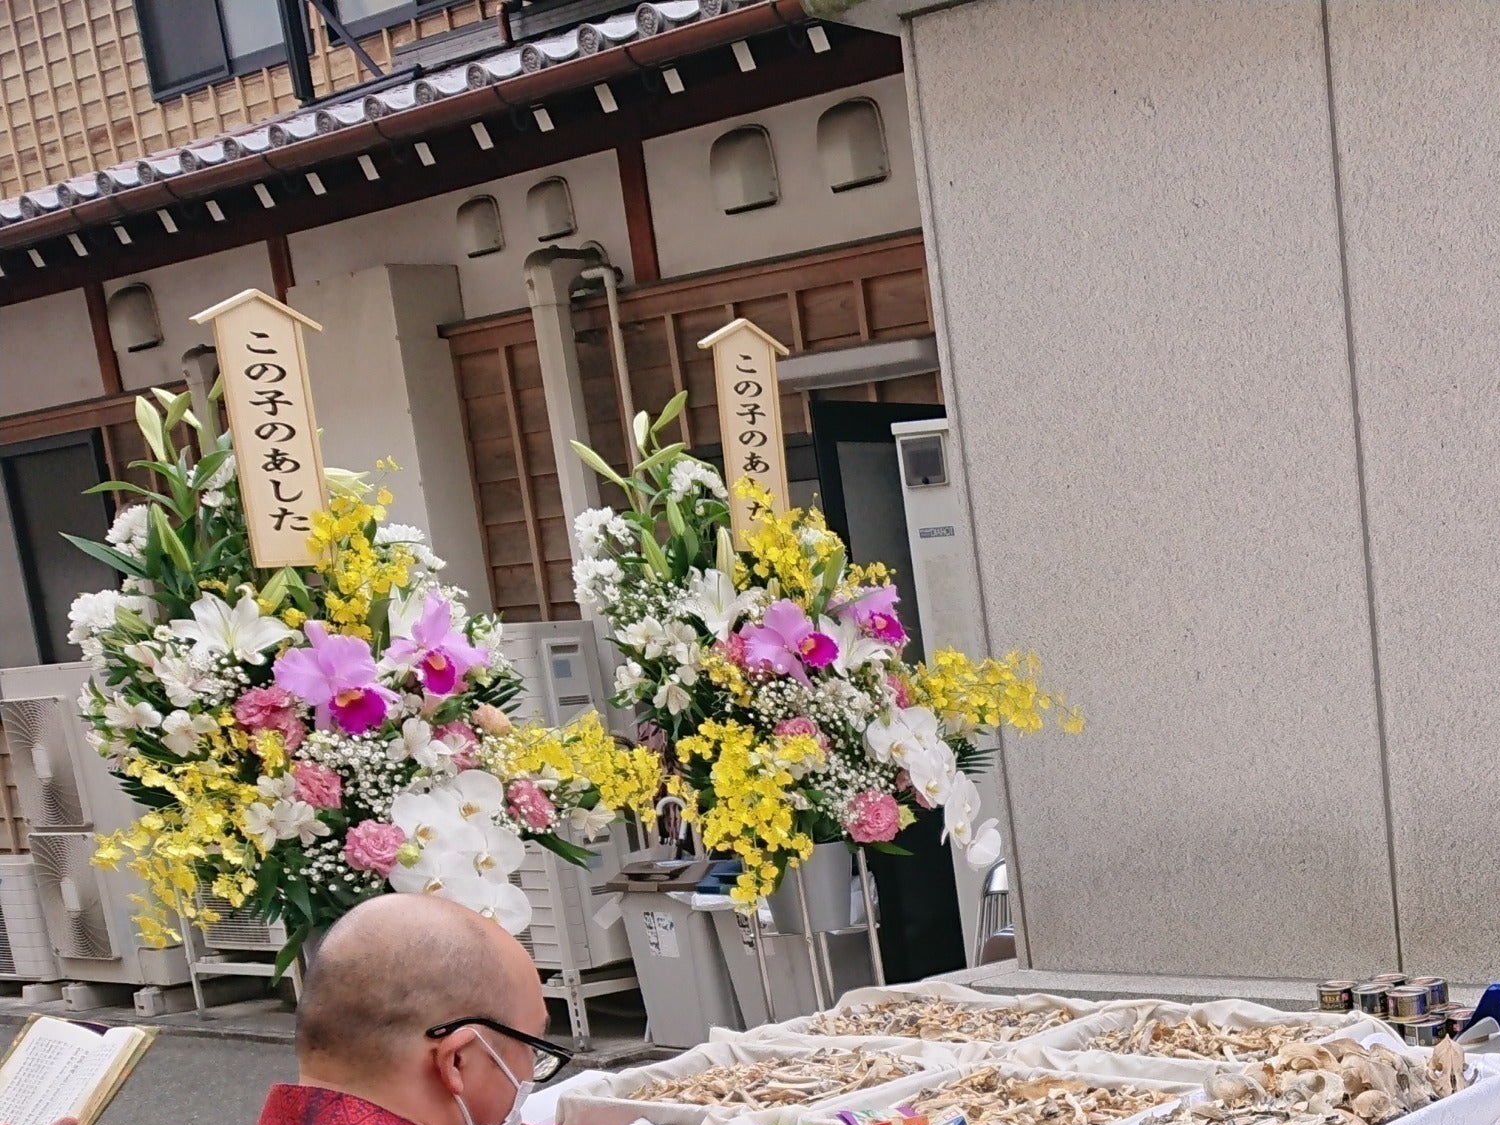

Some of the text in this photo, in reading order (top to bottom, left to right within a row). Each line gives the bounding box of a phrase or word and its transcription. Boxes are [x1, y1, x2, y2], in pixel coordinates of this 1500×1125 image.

[244, 330, 311, 531] この子のあした
